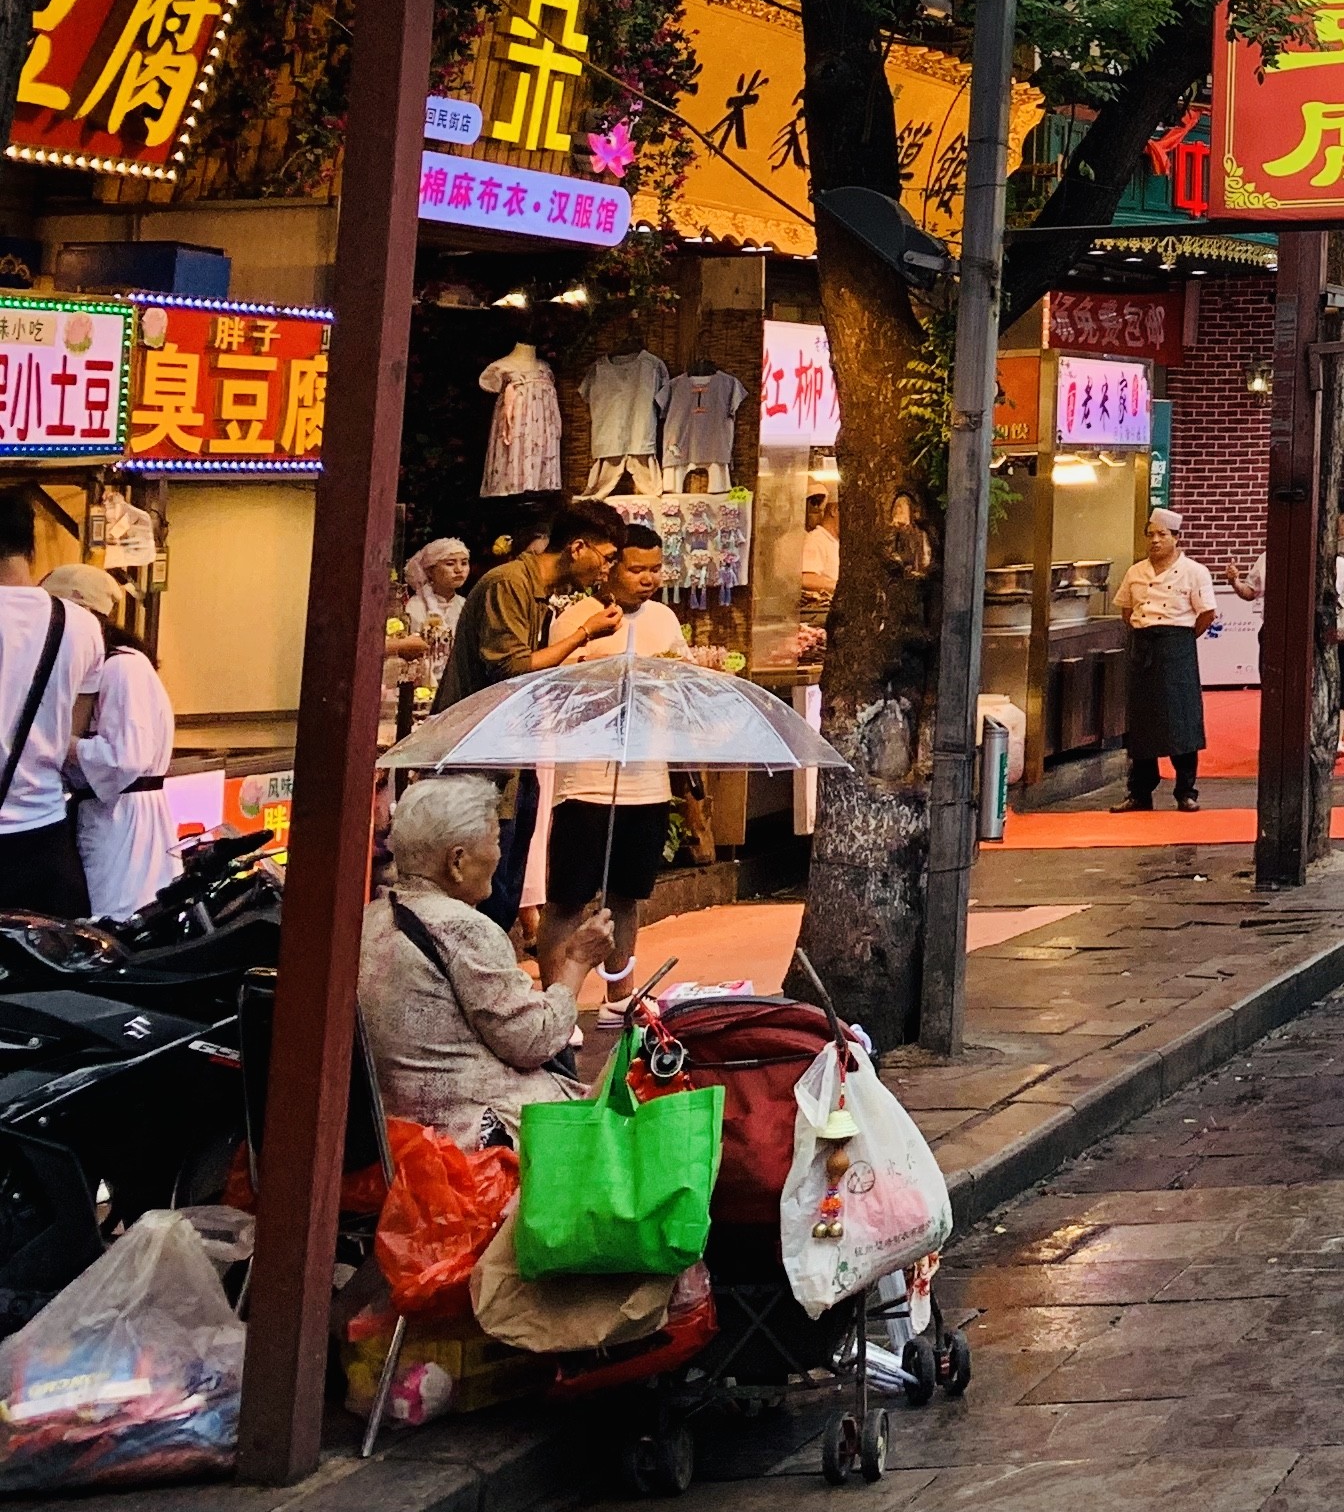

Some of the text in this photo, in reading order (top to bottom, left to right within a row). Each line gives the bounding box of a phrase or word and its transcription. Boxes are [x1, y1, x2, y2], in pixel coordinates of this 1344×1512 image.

[425, 107, 472, 133] 回民街店
[213, 316, 282, 354] 胖子
[130, 343, 328, 456] 臭豆腐
